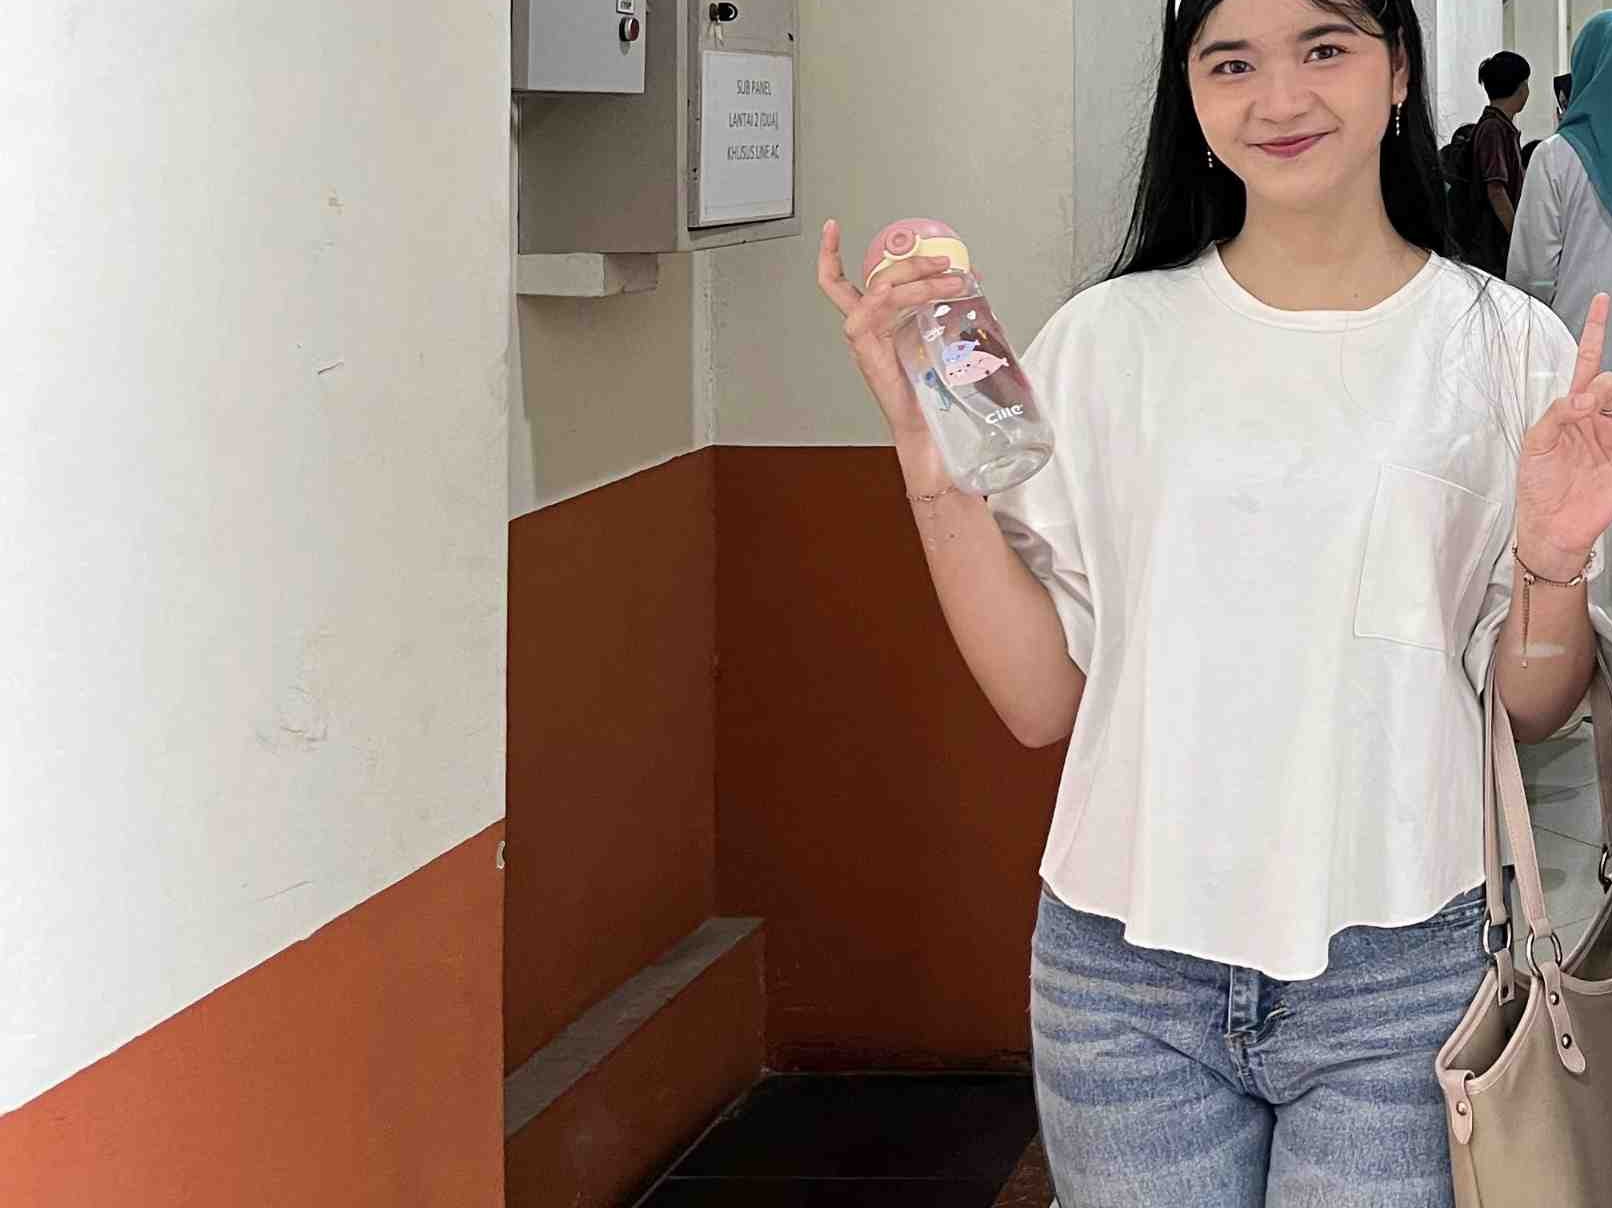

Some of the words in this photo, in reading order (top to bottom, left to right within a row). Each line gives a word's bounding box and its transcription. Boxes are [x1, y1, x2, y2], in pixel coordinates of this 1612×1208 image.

[736, 79, 751, 96] SUB
[751, 79, 772, 96] PANEL
[728, 111, 753, 128] LANTAI
[727, 144, 755, 161] KHUSUS
